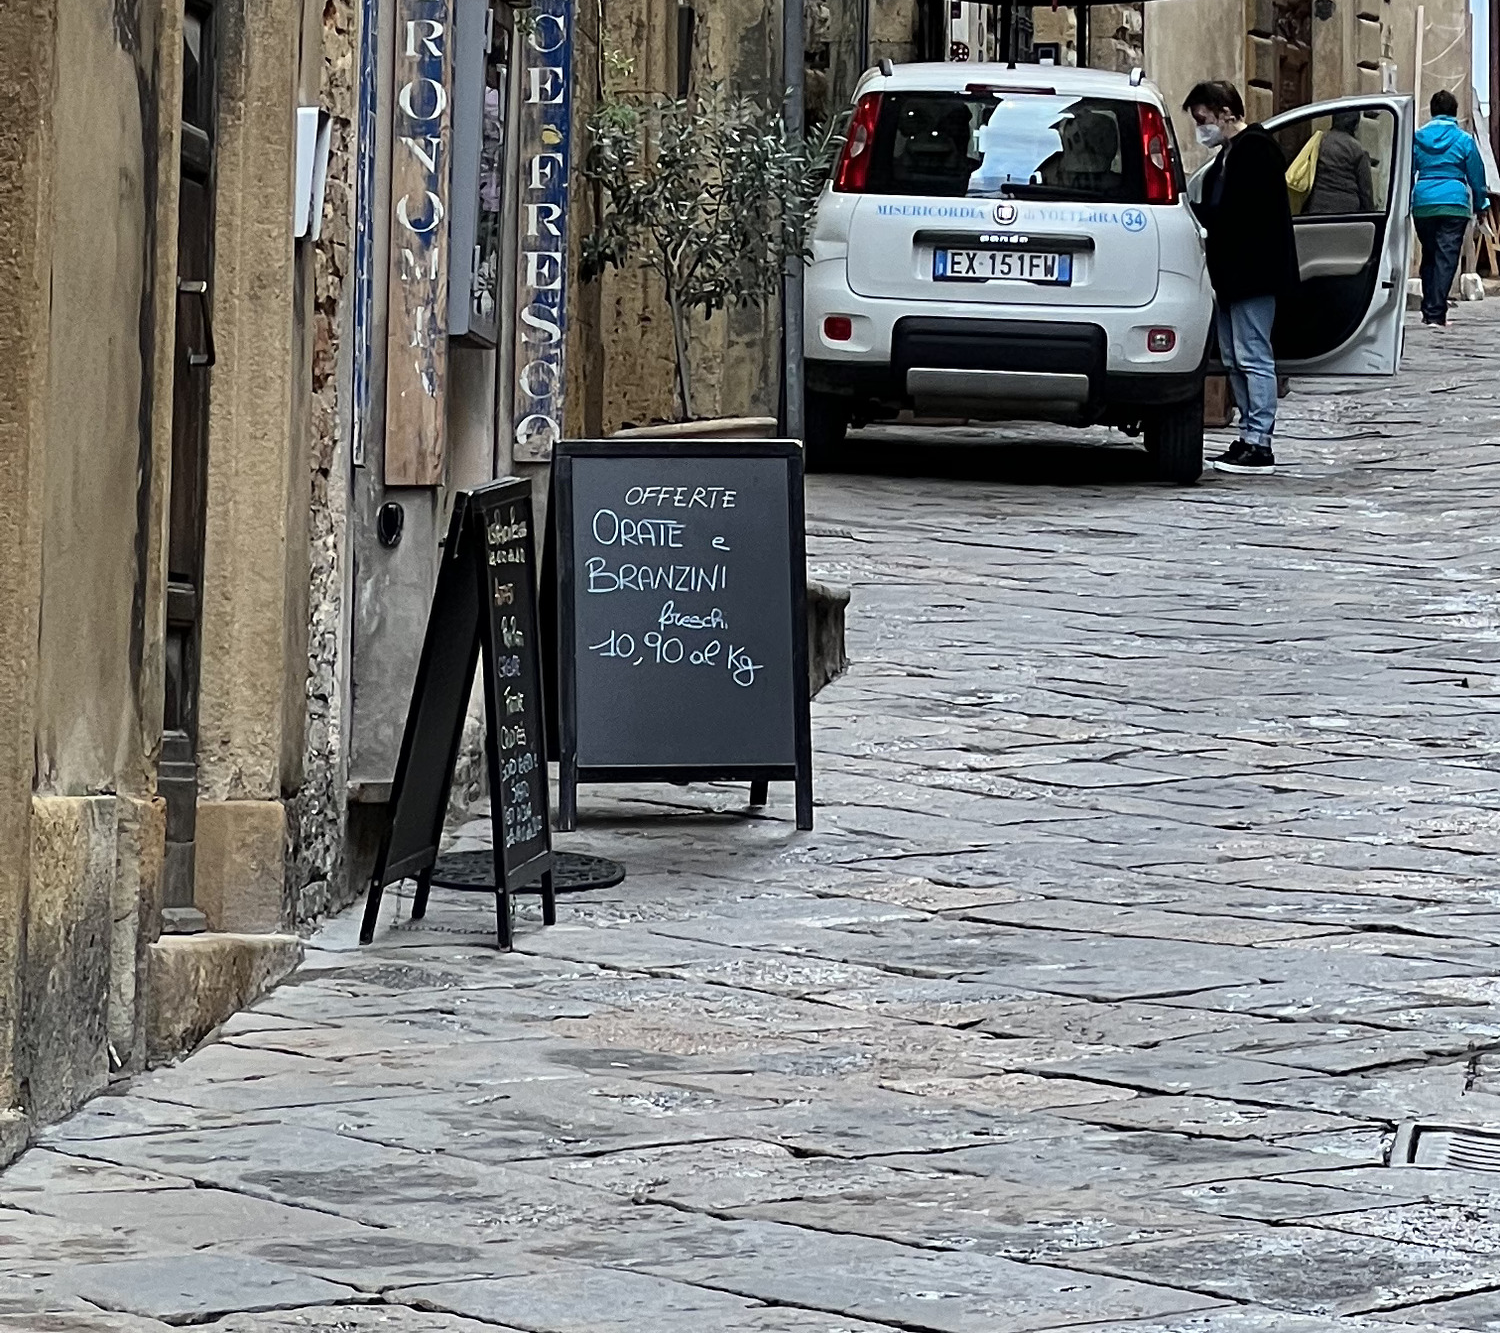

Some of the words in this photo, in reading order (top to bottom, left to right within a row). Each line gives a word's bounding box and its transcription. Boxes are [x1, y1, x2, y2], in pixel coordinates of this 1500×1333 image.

[876, 204, 985, 220] MISERICORDIA
[1124, 212, 1144, 227] 34
[624, 486, 738, 509] OFFERTE
[592, 508, 687, 549] ORATE
[711, 535, 731, 551] e
[584, 555, 729, 594] BRANZINI
[588, 629, 684, 666] 10,90
